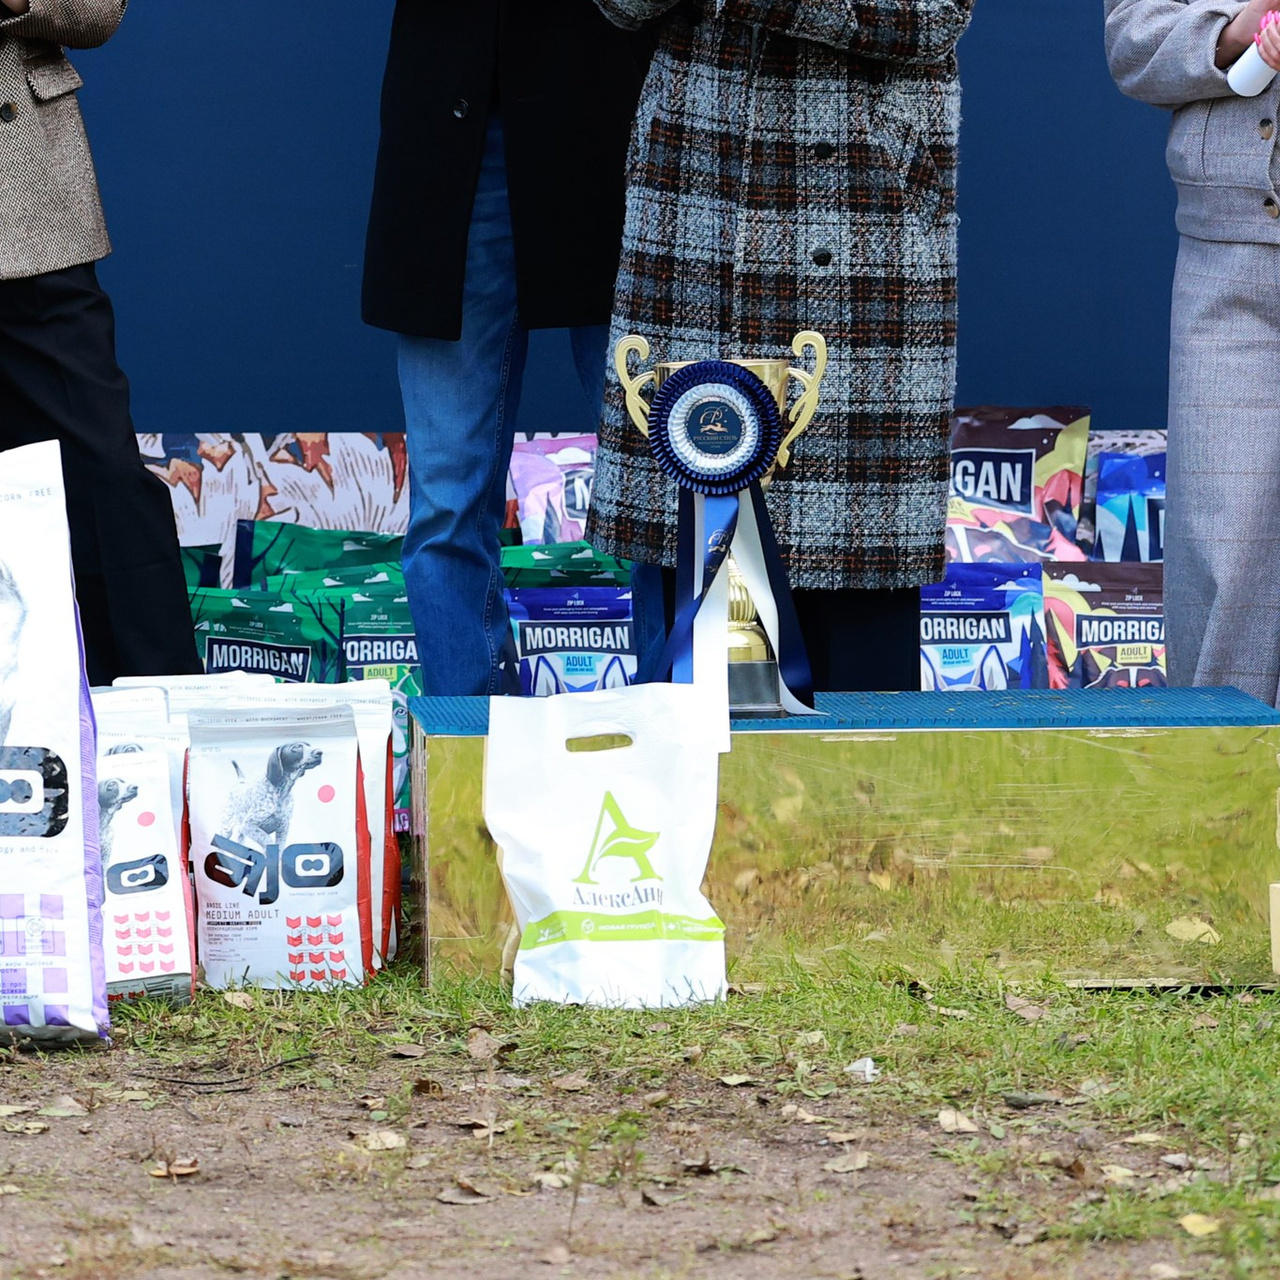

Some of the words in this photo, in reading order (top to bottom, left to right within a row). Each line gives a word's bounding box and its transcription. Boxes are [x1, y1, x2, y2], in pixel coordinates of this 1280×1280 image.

[921, 617, 1006, 640] ORRIGAN
[525, 626, 630, 651] MORRIGAN
[343, 640, 419, 662] ORRIGA
[942, 648, 969, 661] ADULT
[1121, 646, 1148, 657] ADULT
[212, 644, 304, 676] MORRIGAN
[566, 656, 593, 667] ADULT
[367, 667, 394, 678] ADULT
[206, 910, 241, 920] MEDIUM
[248, 909, 280, 919] ADULT
